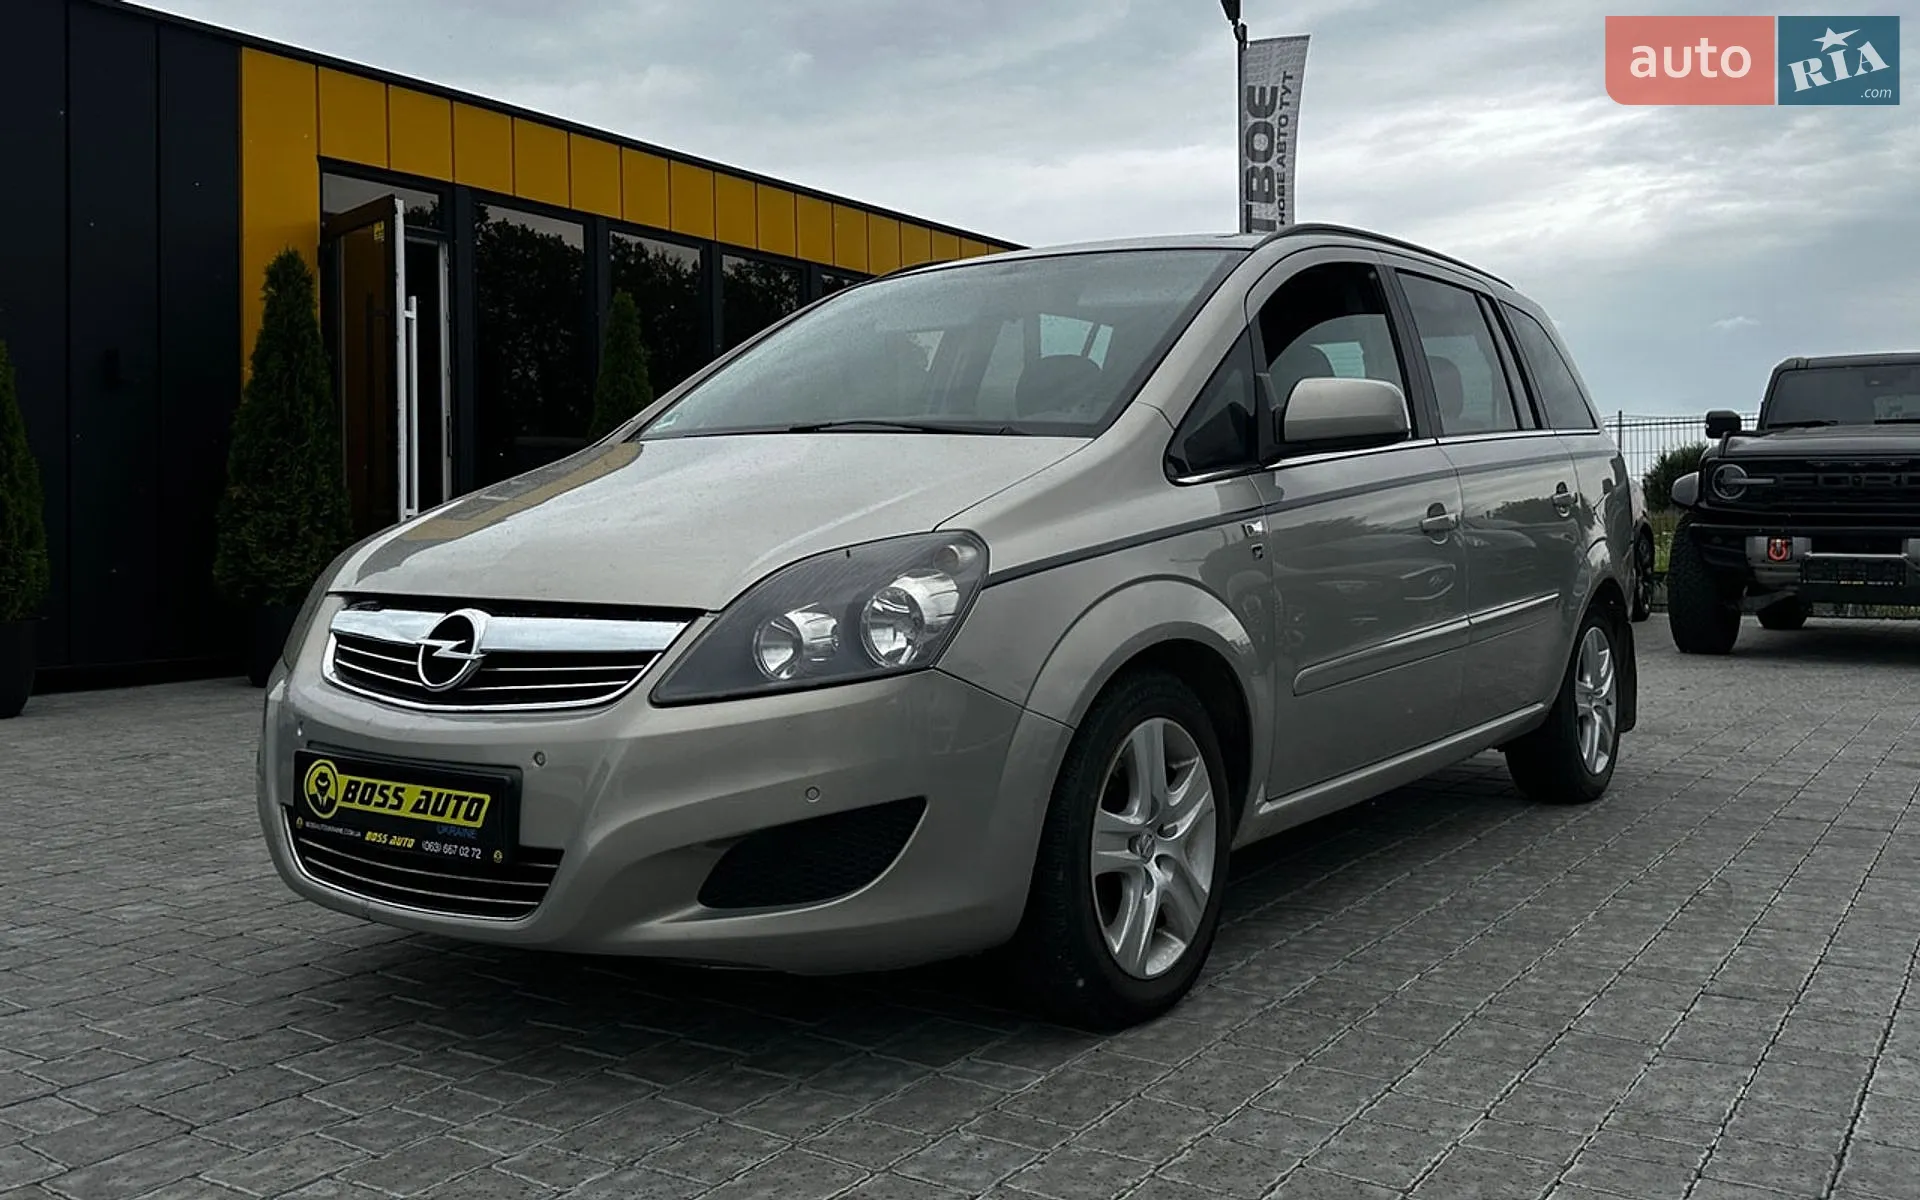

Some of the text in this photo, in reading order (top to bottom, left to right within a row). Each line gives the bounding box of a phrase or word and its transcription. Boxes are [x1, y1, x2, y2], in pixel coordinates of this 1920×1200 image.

[1280, 71, 1293, 110] ТУТ
[1277, 114, 1290, 167] АВТО
[342, 780, 486, 821] BOSS AUTO
[365, 831, 389, 844] BOSS
[471, 847, 482, 859] 72
